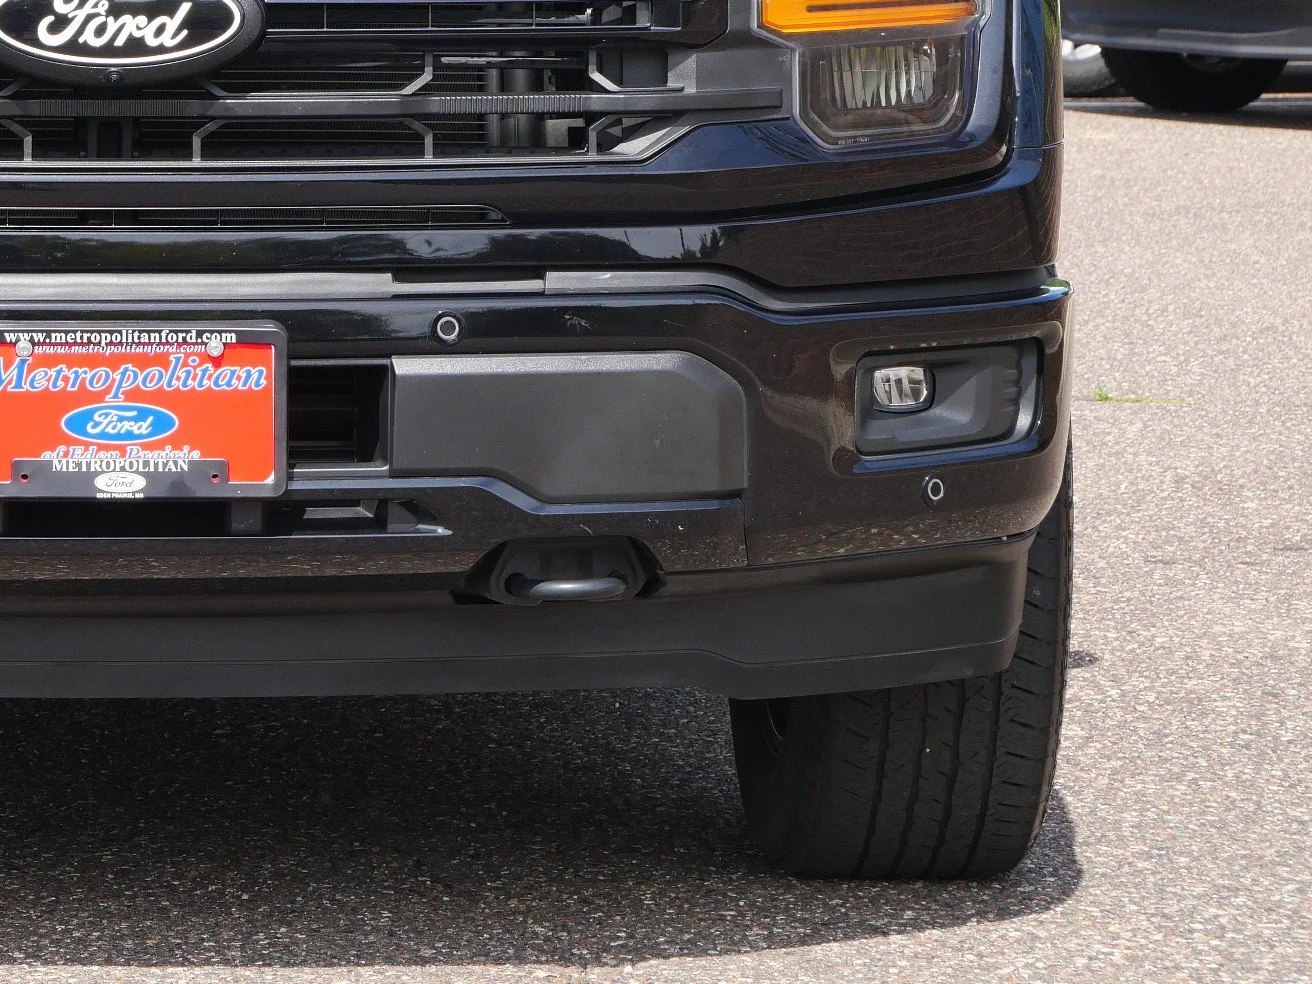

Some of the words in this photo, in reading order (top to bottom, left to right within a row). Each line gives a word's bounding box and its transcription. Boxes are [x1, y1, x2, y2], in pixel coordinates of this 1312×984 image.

[4, 329, 237, 347] www.metropolitanford.com
[34, 342, 206, 356] www.metropolitanford.com
[87, 409, 153, 434] Ford
[52, 459, 189, 472] METROPOLITAN
[106, 475, 135, 487] Ford
